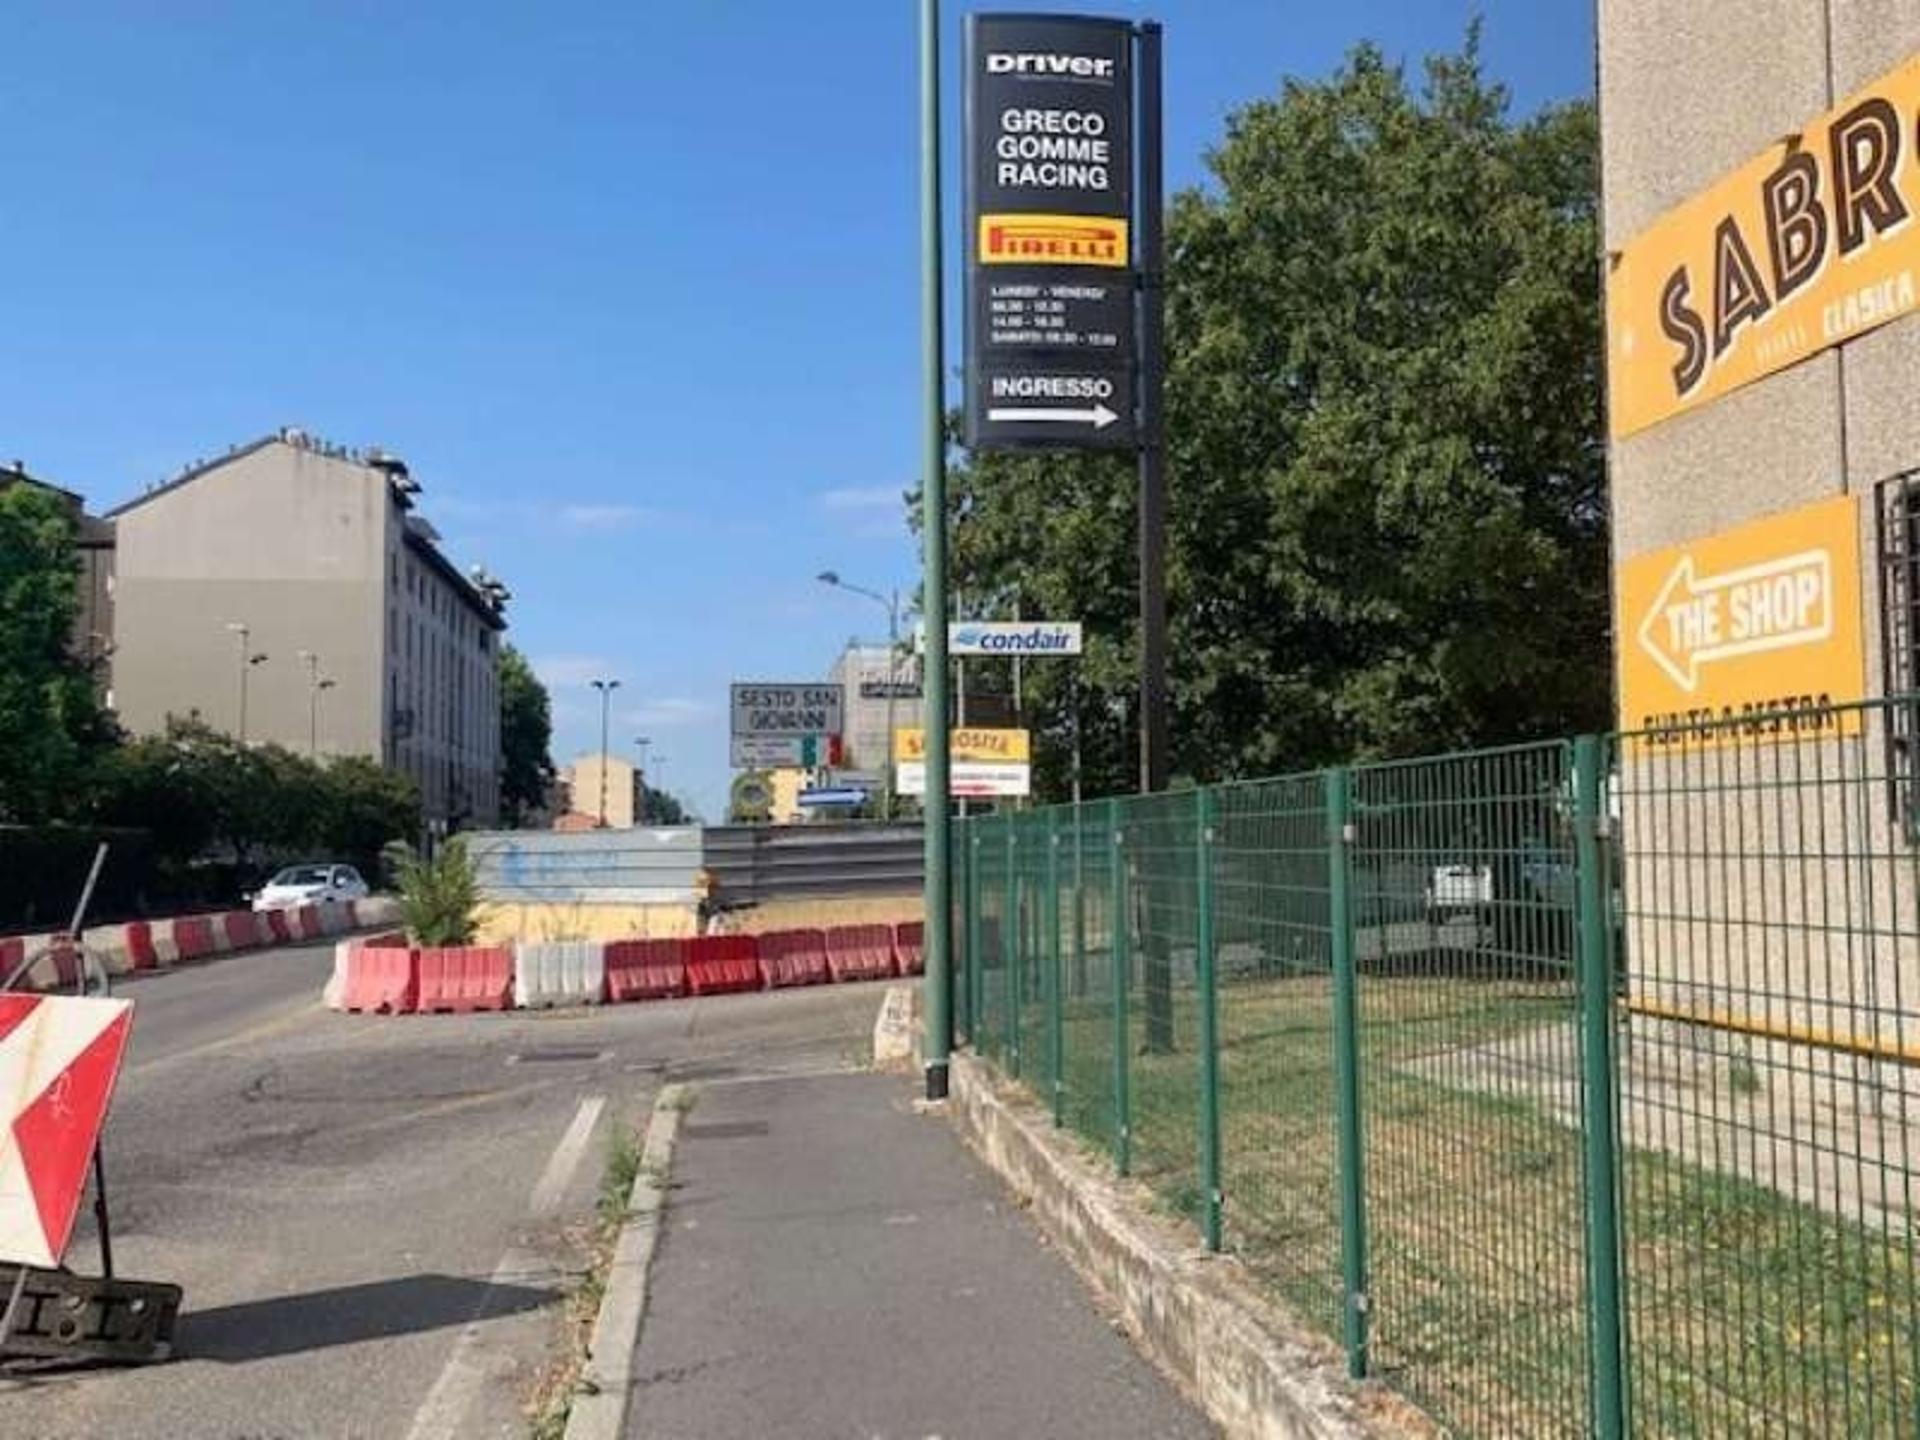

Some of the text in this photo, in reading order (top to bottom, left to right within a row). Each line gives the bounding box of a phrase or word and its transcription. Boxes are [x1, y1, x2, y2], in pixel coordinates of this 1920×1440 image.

[1001, 108, 1105, 135] GRECO
[997, 135, 1110, 162] GOMME
[997, 162, 1108, 189] RACING
[989, 226, 1116, 258] PIRELLI
[1658, 98, 1920, 397] SABR
[992, 377, 1113, 398] INGRESSO
[1666, 569, 1820, 652] THE SHOP
[980, 627, 1070, 650] condair
